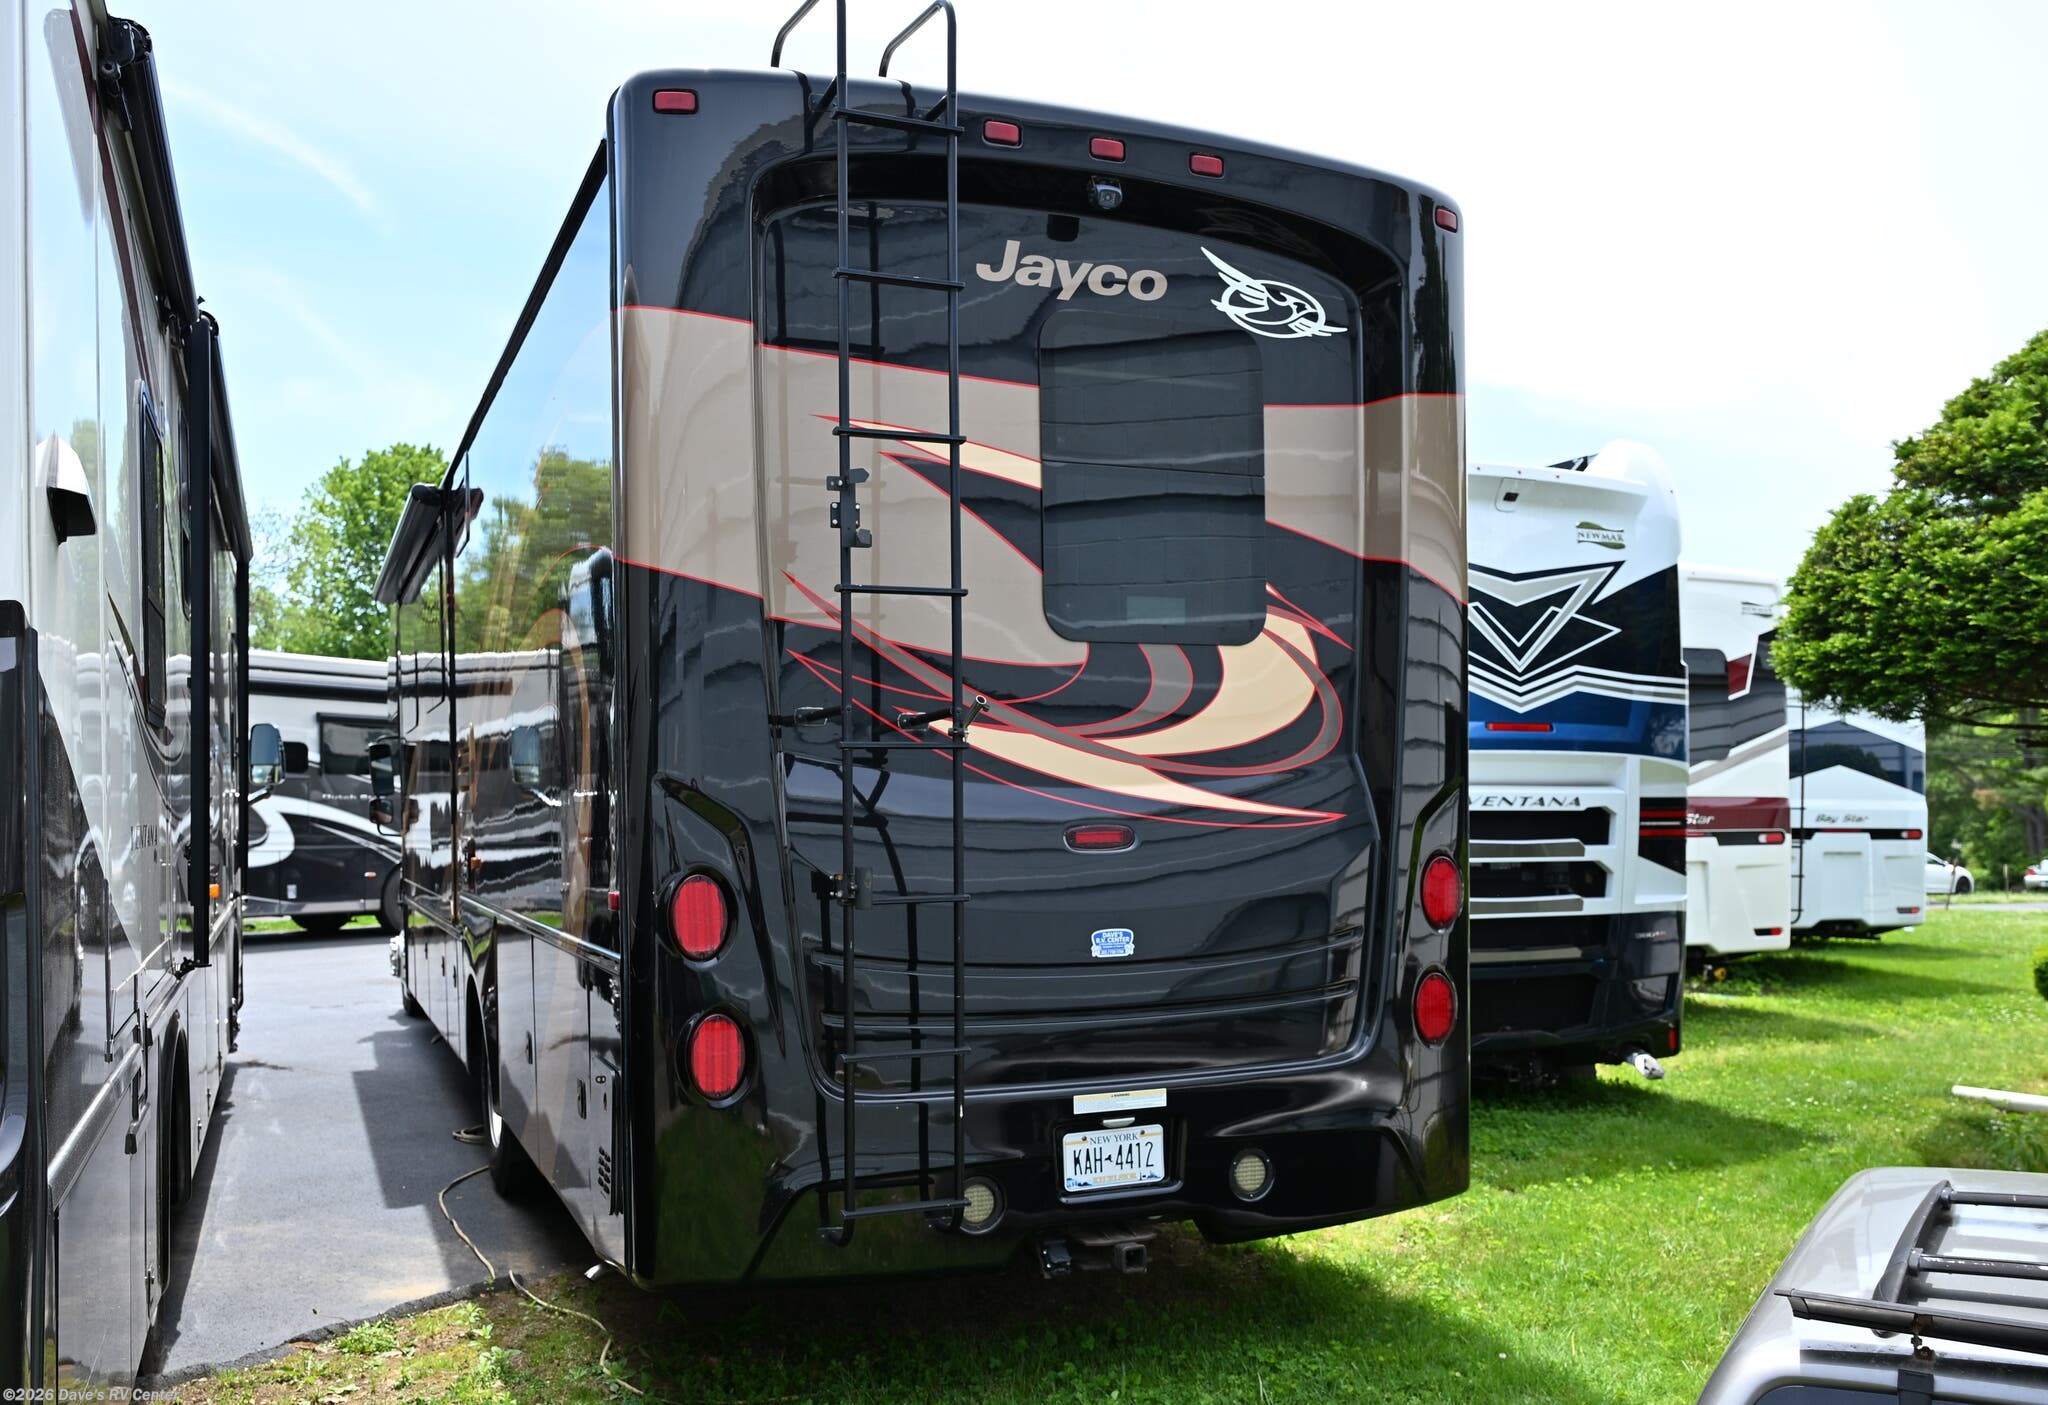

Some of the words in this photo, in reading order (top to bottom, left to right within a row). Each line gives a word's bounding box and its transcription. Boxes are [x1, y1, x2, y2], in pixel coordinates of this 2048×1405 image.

[976, 240, 1168, 300] Jayco
[1089, 1135, 1112, 1145] NEW
[1114, 1132, 1138, 1143] YORK
[1073, 1146, 1103, 1176] KAH
[1115, 1141, 1154, 1170] 4412
